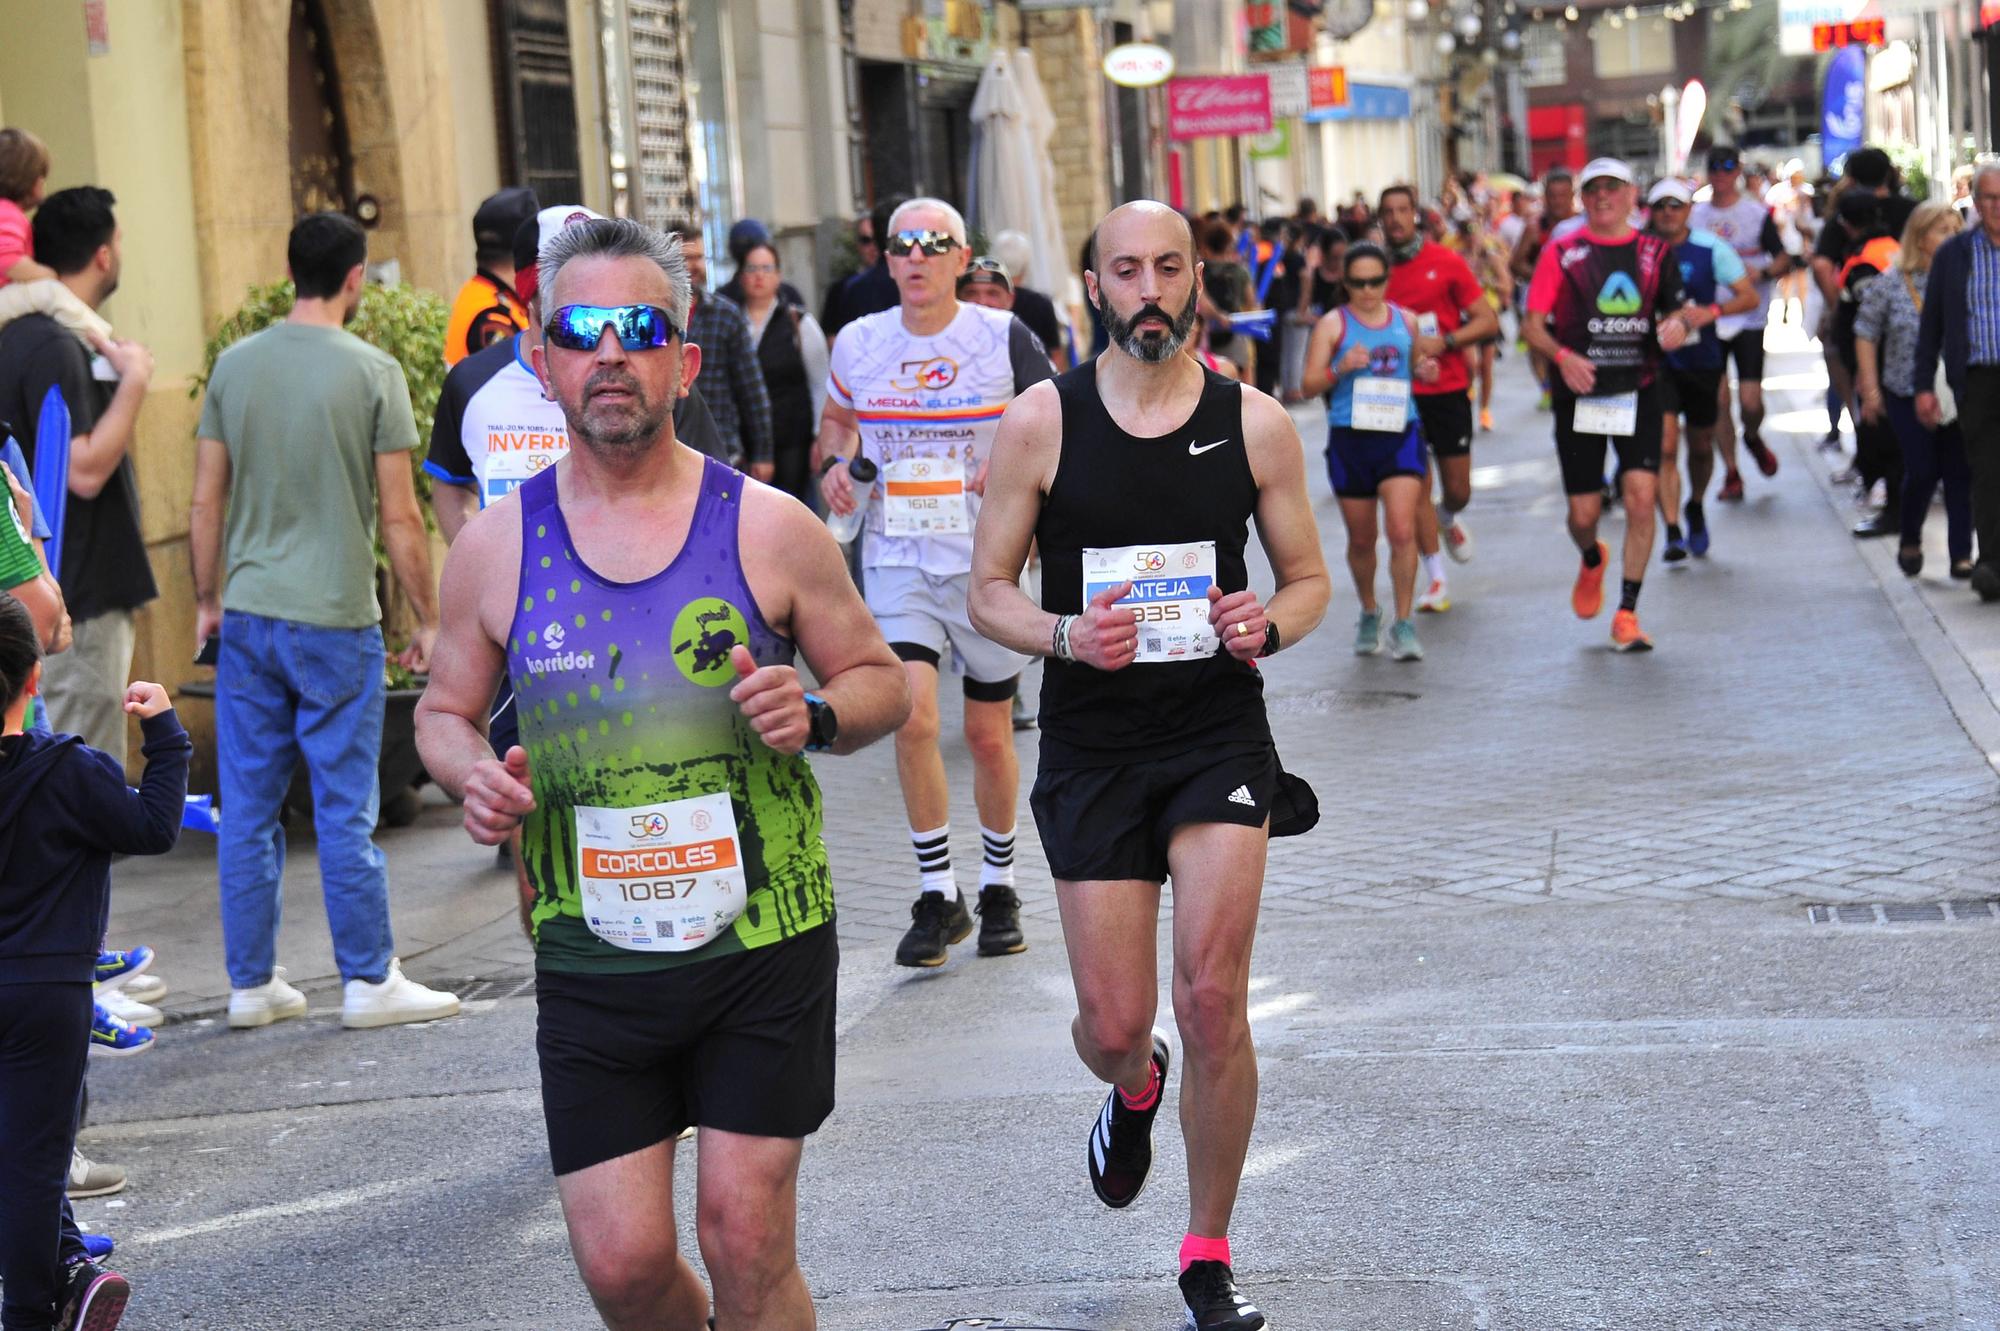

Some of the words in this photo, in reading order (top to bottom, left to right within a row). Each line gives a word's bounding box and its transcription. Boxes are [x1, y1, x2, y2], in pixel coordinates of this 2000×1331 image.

[867, 398, 921, 408] MEDIA
[926, 396, 982, 409] ELCHE
[907, 498, 940, 510] 1612
[525, 651, 595, 675] korridor
[1227, 795, 1256, 807] adidas
[596, 844, 717, 874] CORCOLES
[618, 878, 697, 902] 1087
